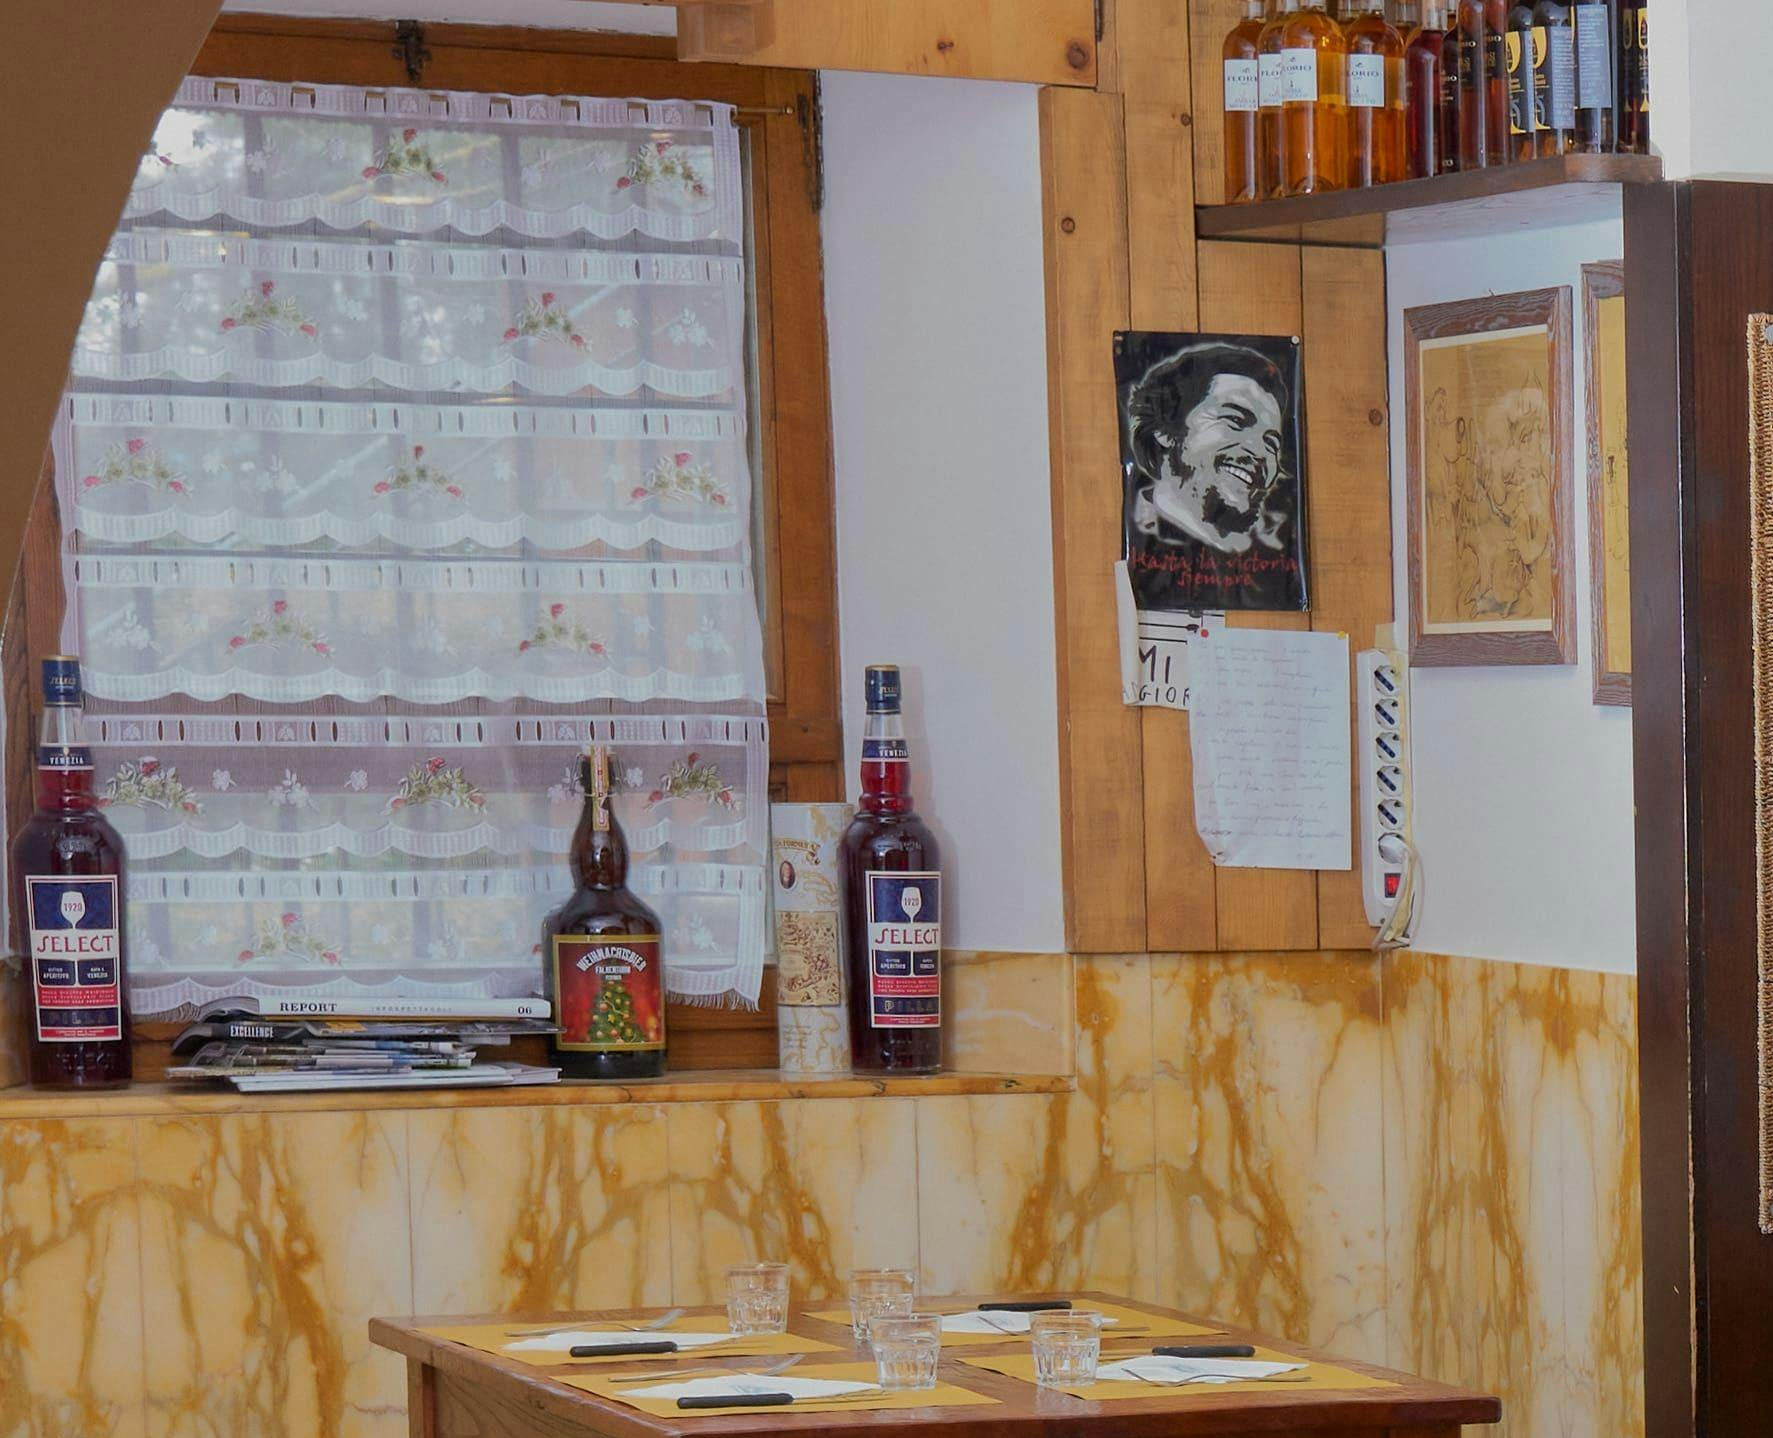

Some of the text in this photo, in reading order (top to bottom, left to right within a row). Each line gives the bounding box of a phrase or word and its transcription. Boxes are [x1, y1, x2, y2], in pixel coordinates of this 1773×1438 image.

[1225, 551, 1299, 574] victoria
[63, 902, 83, 912] 1920
[36, 934, 114, 953] SELECT
[874, 927, 939, 945] SELECT
[576, 946, 647, 972] WEIHNACHTSBIER
[280, 1001, 337, 1013] REPORT
[517, 1006, 532, 1015] 06
[230, 1025, 274, 1038] EXCELLENCE
